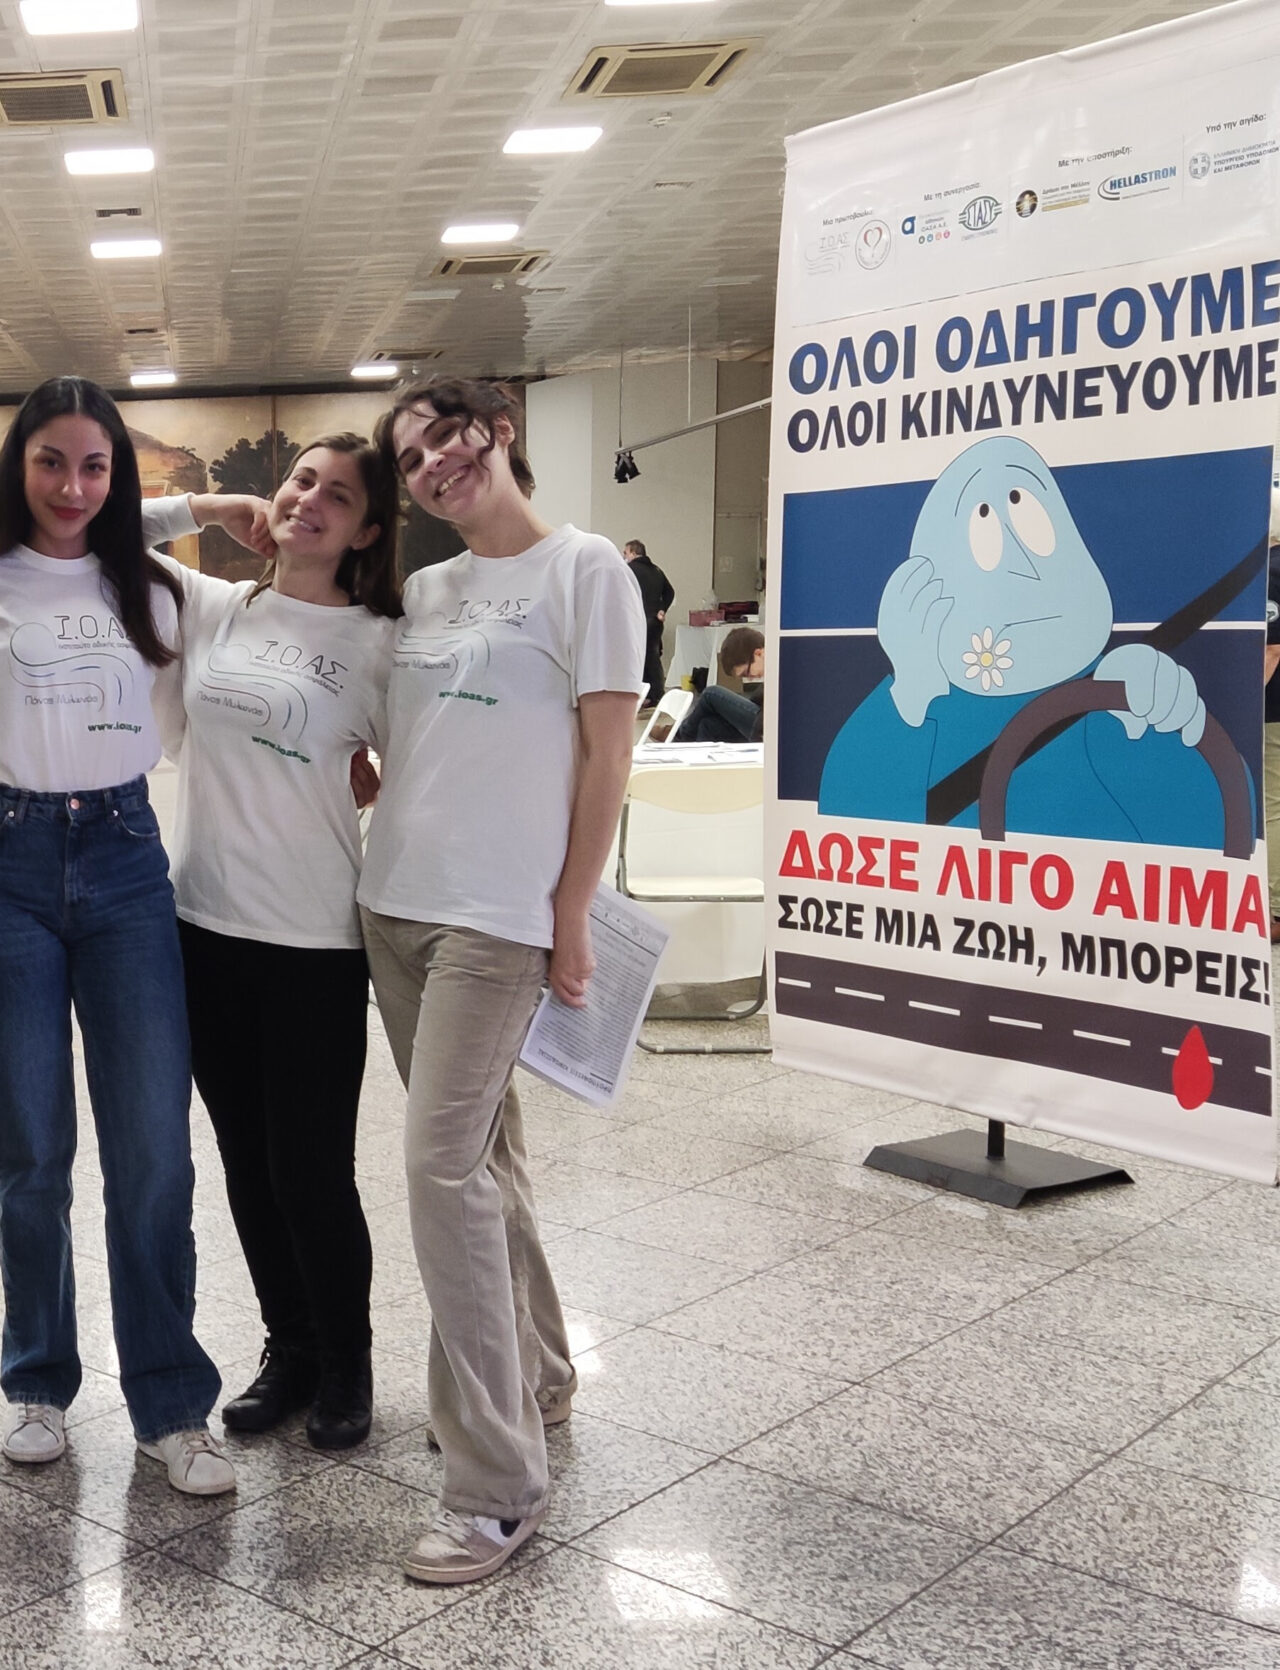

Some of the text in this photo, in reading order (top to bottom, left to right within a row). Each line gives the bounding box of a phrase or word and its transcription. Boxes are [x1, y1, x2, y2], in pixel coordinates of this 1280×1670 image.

[1110, 166, 1177, 191] HELLASTRON
[788, 259, 1280, 396] ΟΛΟΙ ΟΔΗΓΟΥΜΕ
[787, 338, 1279, 454] ΟΛΟΙ ΚΙΝΔΥΝΕΥΟΥΜΕ
[778, 829, 1267, 939] ΔΩΣΕ ΛΙΓΟ ΑΙΜΑ
[777, 894, 1270, 1006] ΣΩΣΕ ΜΙΑ ΖΩΗ, ΜΠΟΡΕΙΣ!
